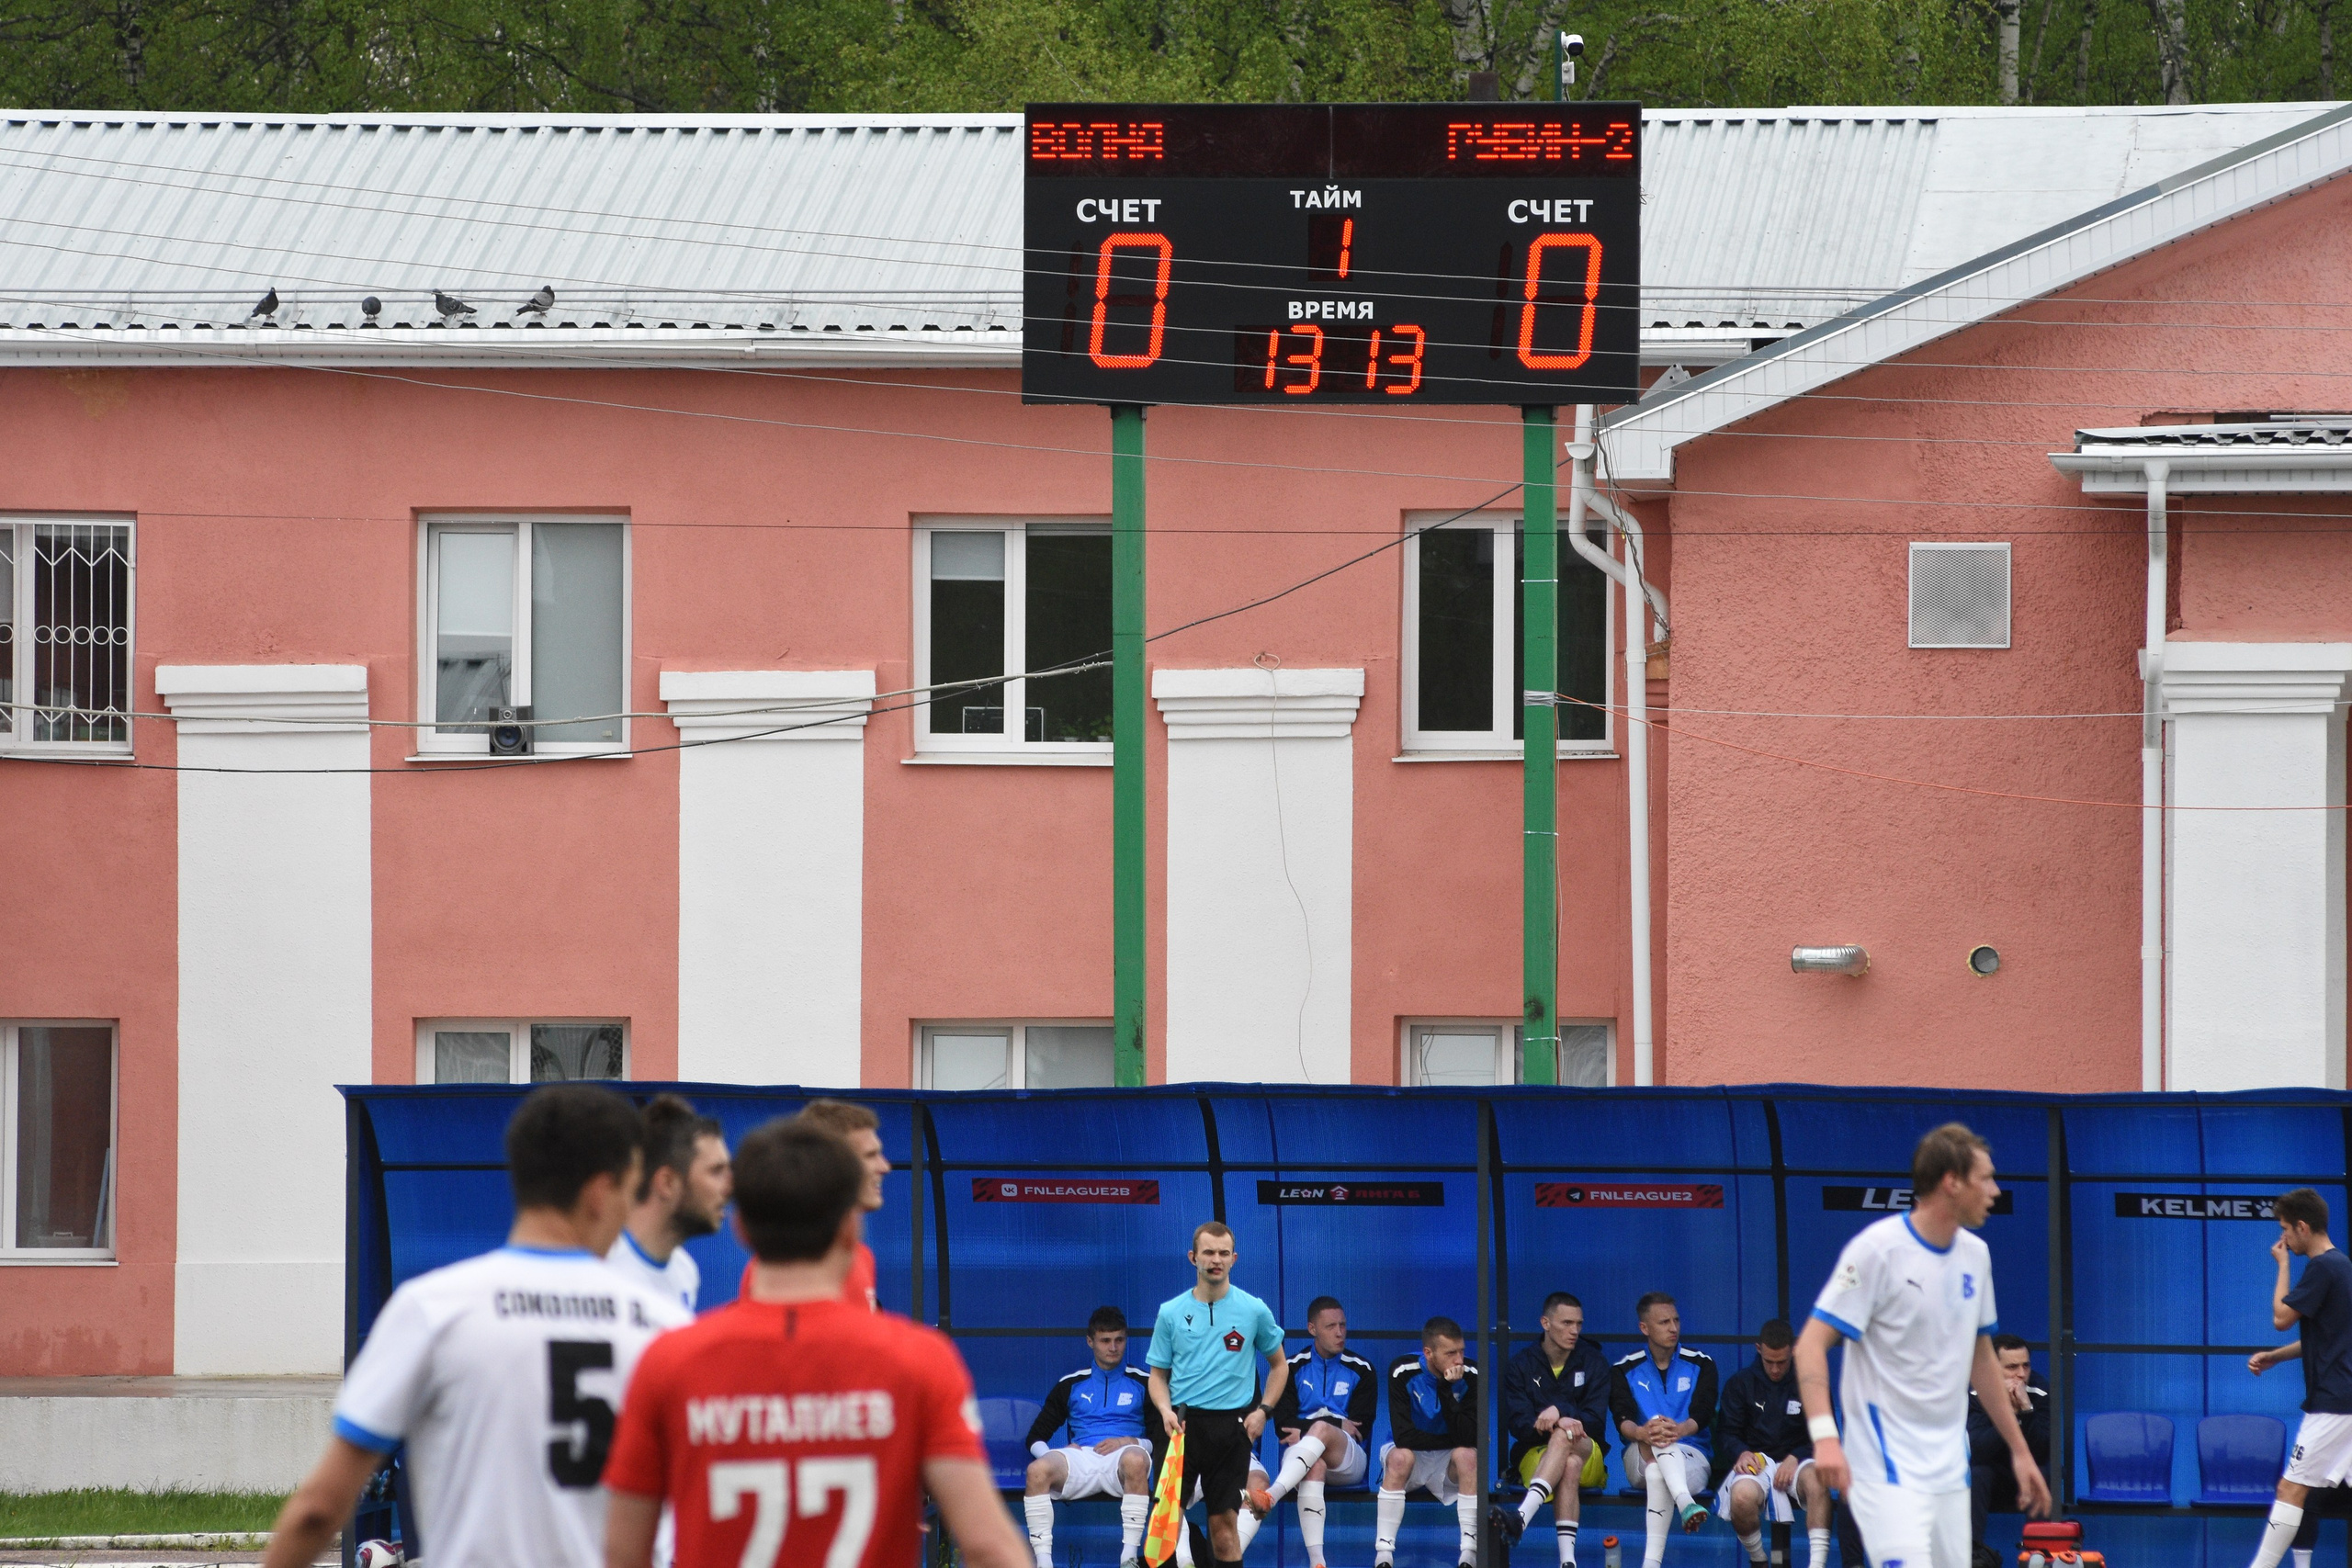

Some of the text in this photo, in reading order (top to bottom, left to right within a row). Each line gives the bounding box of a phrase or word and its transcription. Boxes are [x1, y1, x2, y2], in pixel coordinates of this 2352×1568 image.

[1032, 122, 1163, 159] ВОЛНА
[1076, 197, 1161, 223] СЧЕТ
[1290, 186, 1362, 209] ТАЙМ
[1507, 198, 1594, 223] СЧЕТ
[1339, 219, 1353, 278] 1
[1089, 233, 1172, 367] 0
[1287, 300, 1374, 321] ВРЕМЯ
[1518, 233, 1602, 368] 0
[1024, 1186, 1130, 1196] FNLEAGUE2B
[1590, 1190, 1692, 1201] FNLEAGUE2
[1861, 1188, 1916, 1209] LE
[2141, 1198, 2253, 1217] KELME
[1230, 1337, 1238, 1346] 2
[546, 1339, 617, 1489] 5
[686, 1390, 895, 1445] МУТАЛИЕВ
[707, 1457, 877, 1568] 77
